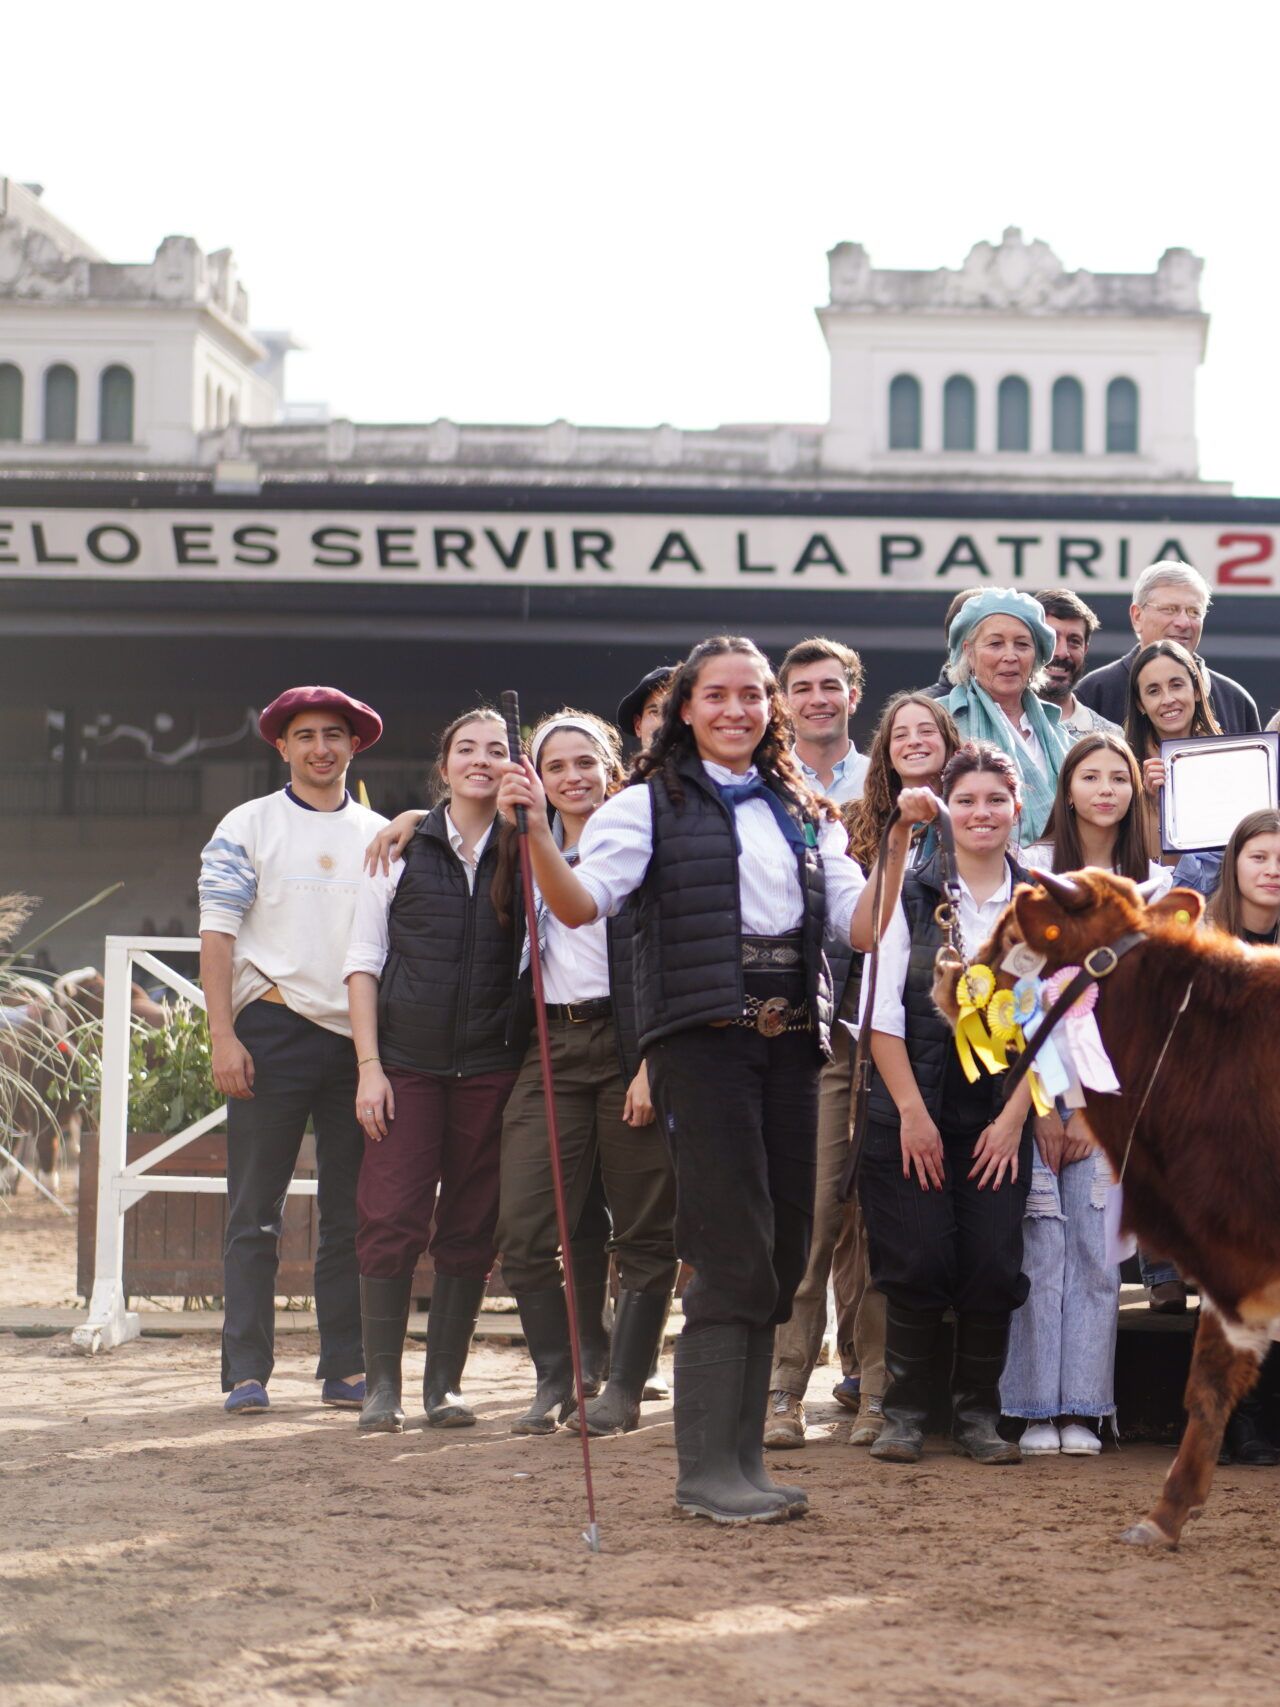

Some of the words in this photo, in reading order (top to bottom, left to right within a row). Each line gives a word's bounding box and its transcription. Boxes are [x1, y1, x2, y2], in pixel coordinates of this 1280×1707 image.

[172, 523, 280, 566] ES
[310, 525, 615, 570] SERVIR
[648, 529, 704, 573] A
[737, 531, 847, 575] LA
